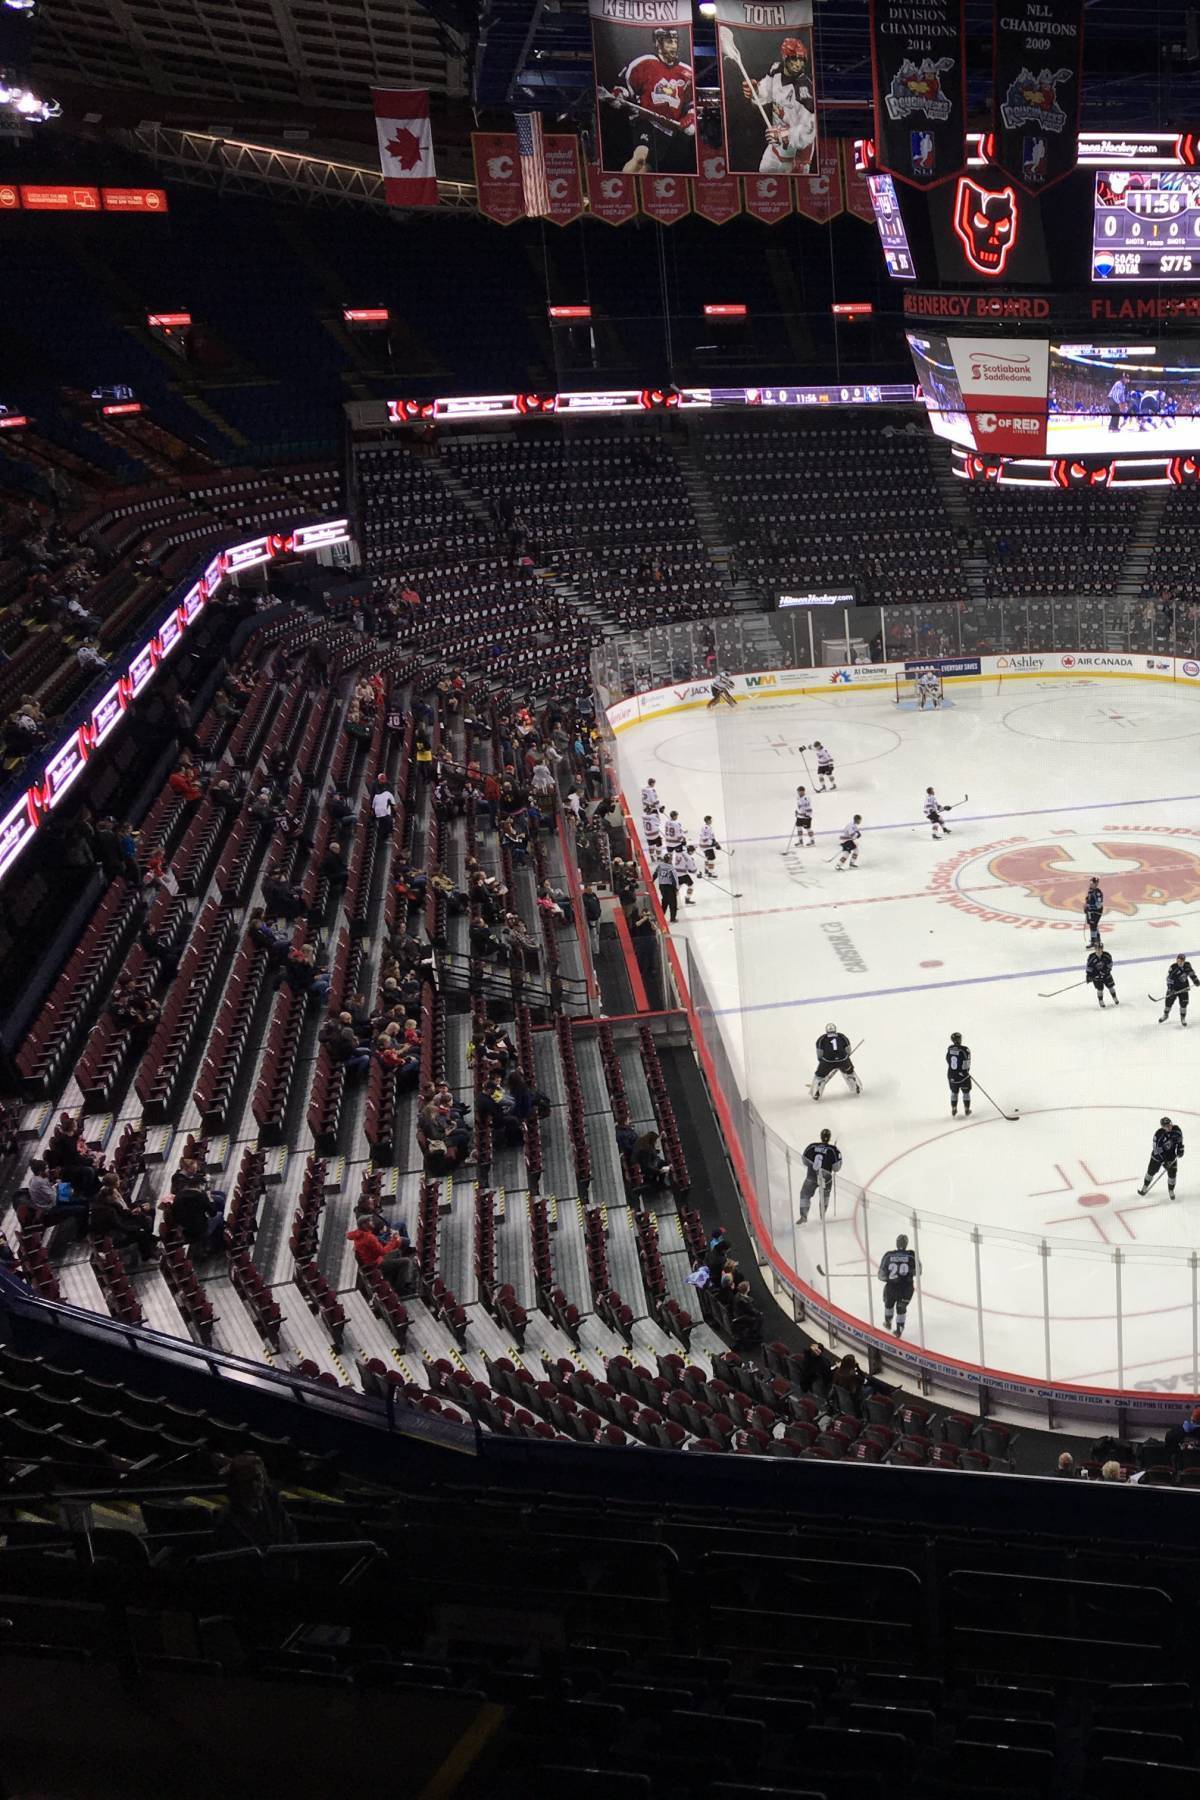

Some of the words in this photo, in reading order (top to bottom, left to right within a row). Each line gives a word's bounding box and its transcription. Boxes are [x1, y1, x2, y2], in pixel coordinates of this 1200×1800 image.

[604, 0, 678, 21] KELUSKY
[743, 3, 785, 25] TOTH
[889, 7, 946, 21] DIVISION
[1027, 4, 1053, 17] NLL
[880, 23, 959, 36] CHAMPIONS
[1000, 17, 1077, 36] CHAMPIONS
[907, 39, 932, 51] 2014
[1026, 38, 1050, 50] 2009
[1134, 194, 1179, 213] 11:56
[1105, 216, 1116, 236] 0
[1132, 223, 1141, 237] 0
[1153, 224, 1158, 236] 1
[1170, 223, 1178, 237] 0
[1115, 254, 1140, 264] 50/50
[1160, 256, 1192, 272] $775
[1115, 264, 1139, 273] TOTAL
[918, 295, 970, 316] ENERGY
[976, 297, 1050, 319] BOARD
[1090, 298, 1180, 319] FLAMES
[982, 364, 1031, 374] Scotiabank
[984, 373, 1031, 382] Saddledome
[796, 393, 816, 403] 11:56
[998, 419, 1012, 427] OF
[1012, 419, 1040, 430] RED
[941, 664, 963, 672] EVERYDAY
[1009, 656, 1046, 669] Ashley
[1078, 657, 1092, 665] AIR
[1094, 657, 1133, 667] CANADA
[745, 675, 776, 686] WM
[830, 1037, 838, 1051] 1
